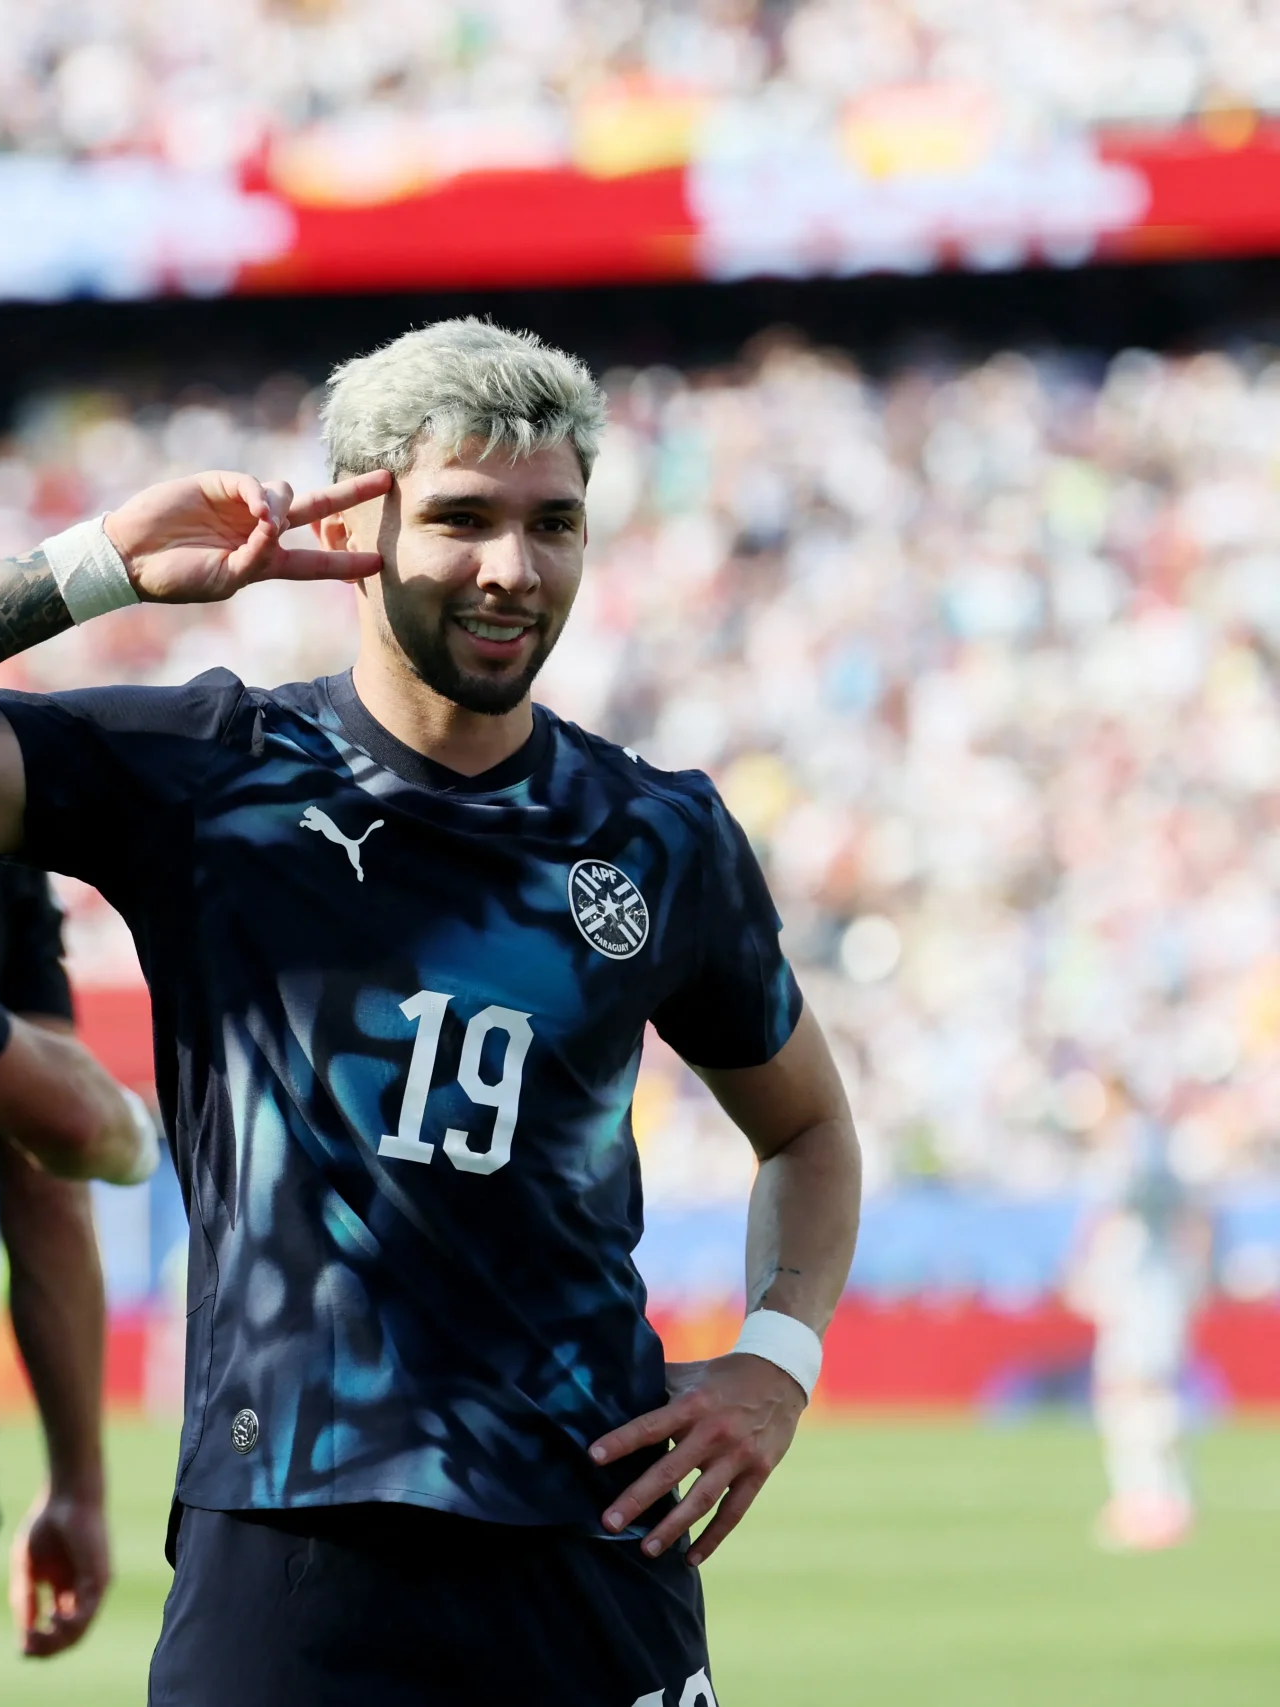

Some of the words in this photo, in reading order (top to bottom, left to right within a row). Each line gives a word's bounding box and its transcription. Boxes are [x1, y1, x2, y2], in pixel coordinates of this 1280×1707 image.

[591, 866, 617, 884] APF
[593, 933, 629, 953] PARAGUAY
[377, 989, 534, 1175] 19
